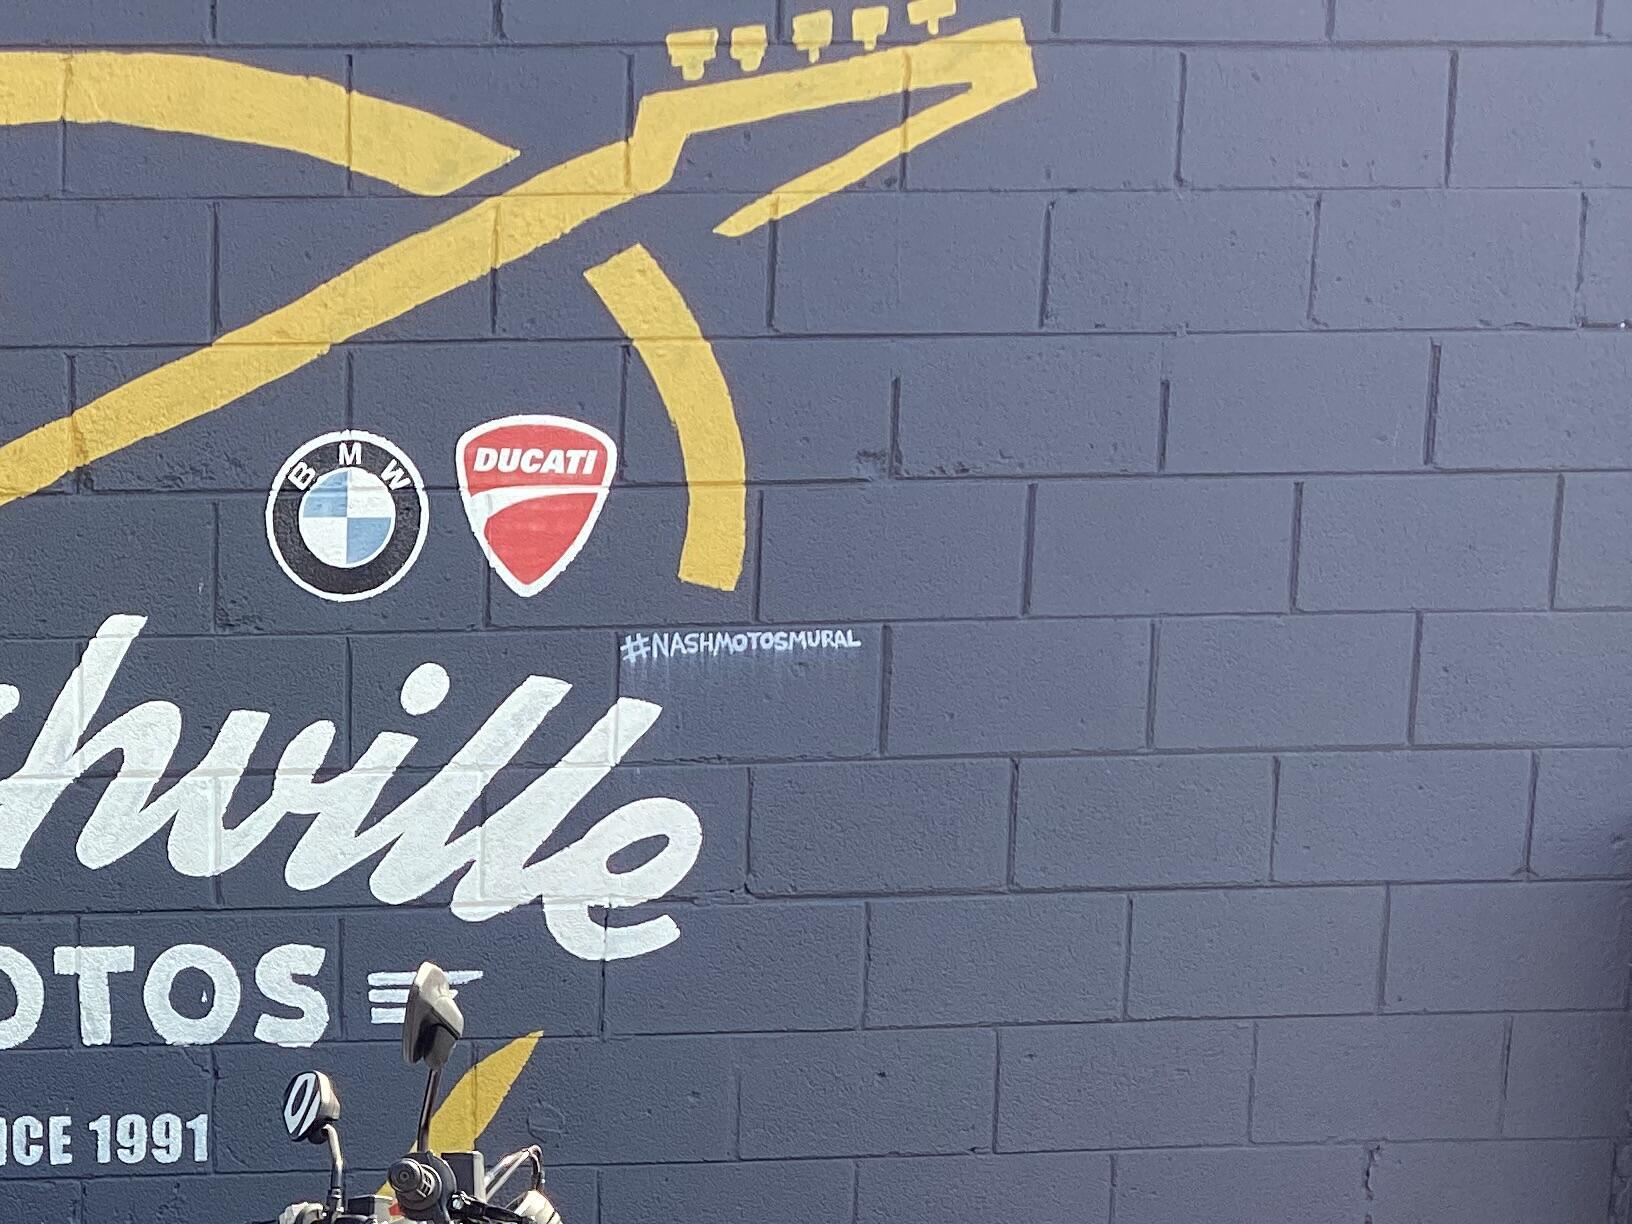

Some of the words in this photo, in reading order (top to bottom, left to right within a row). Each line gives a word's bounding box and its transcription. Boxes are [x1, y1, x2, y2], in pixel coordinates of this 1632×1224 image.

[288, 441, 412, 492] BMW
[473, 446, 599, 475] DUCATI
[620, 629, 862, 667] #NASHMOTOSMURAL
[88, 1112, 209, 1164] 1991
